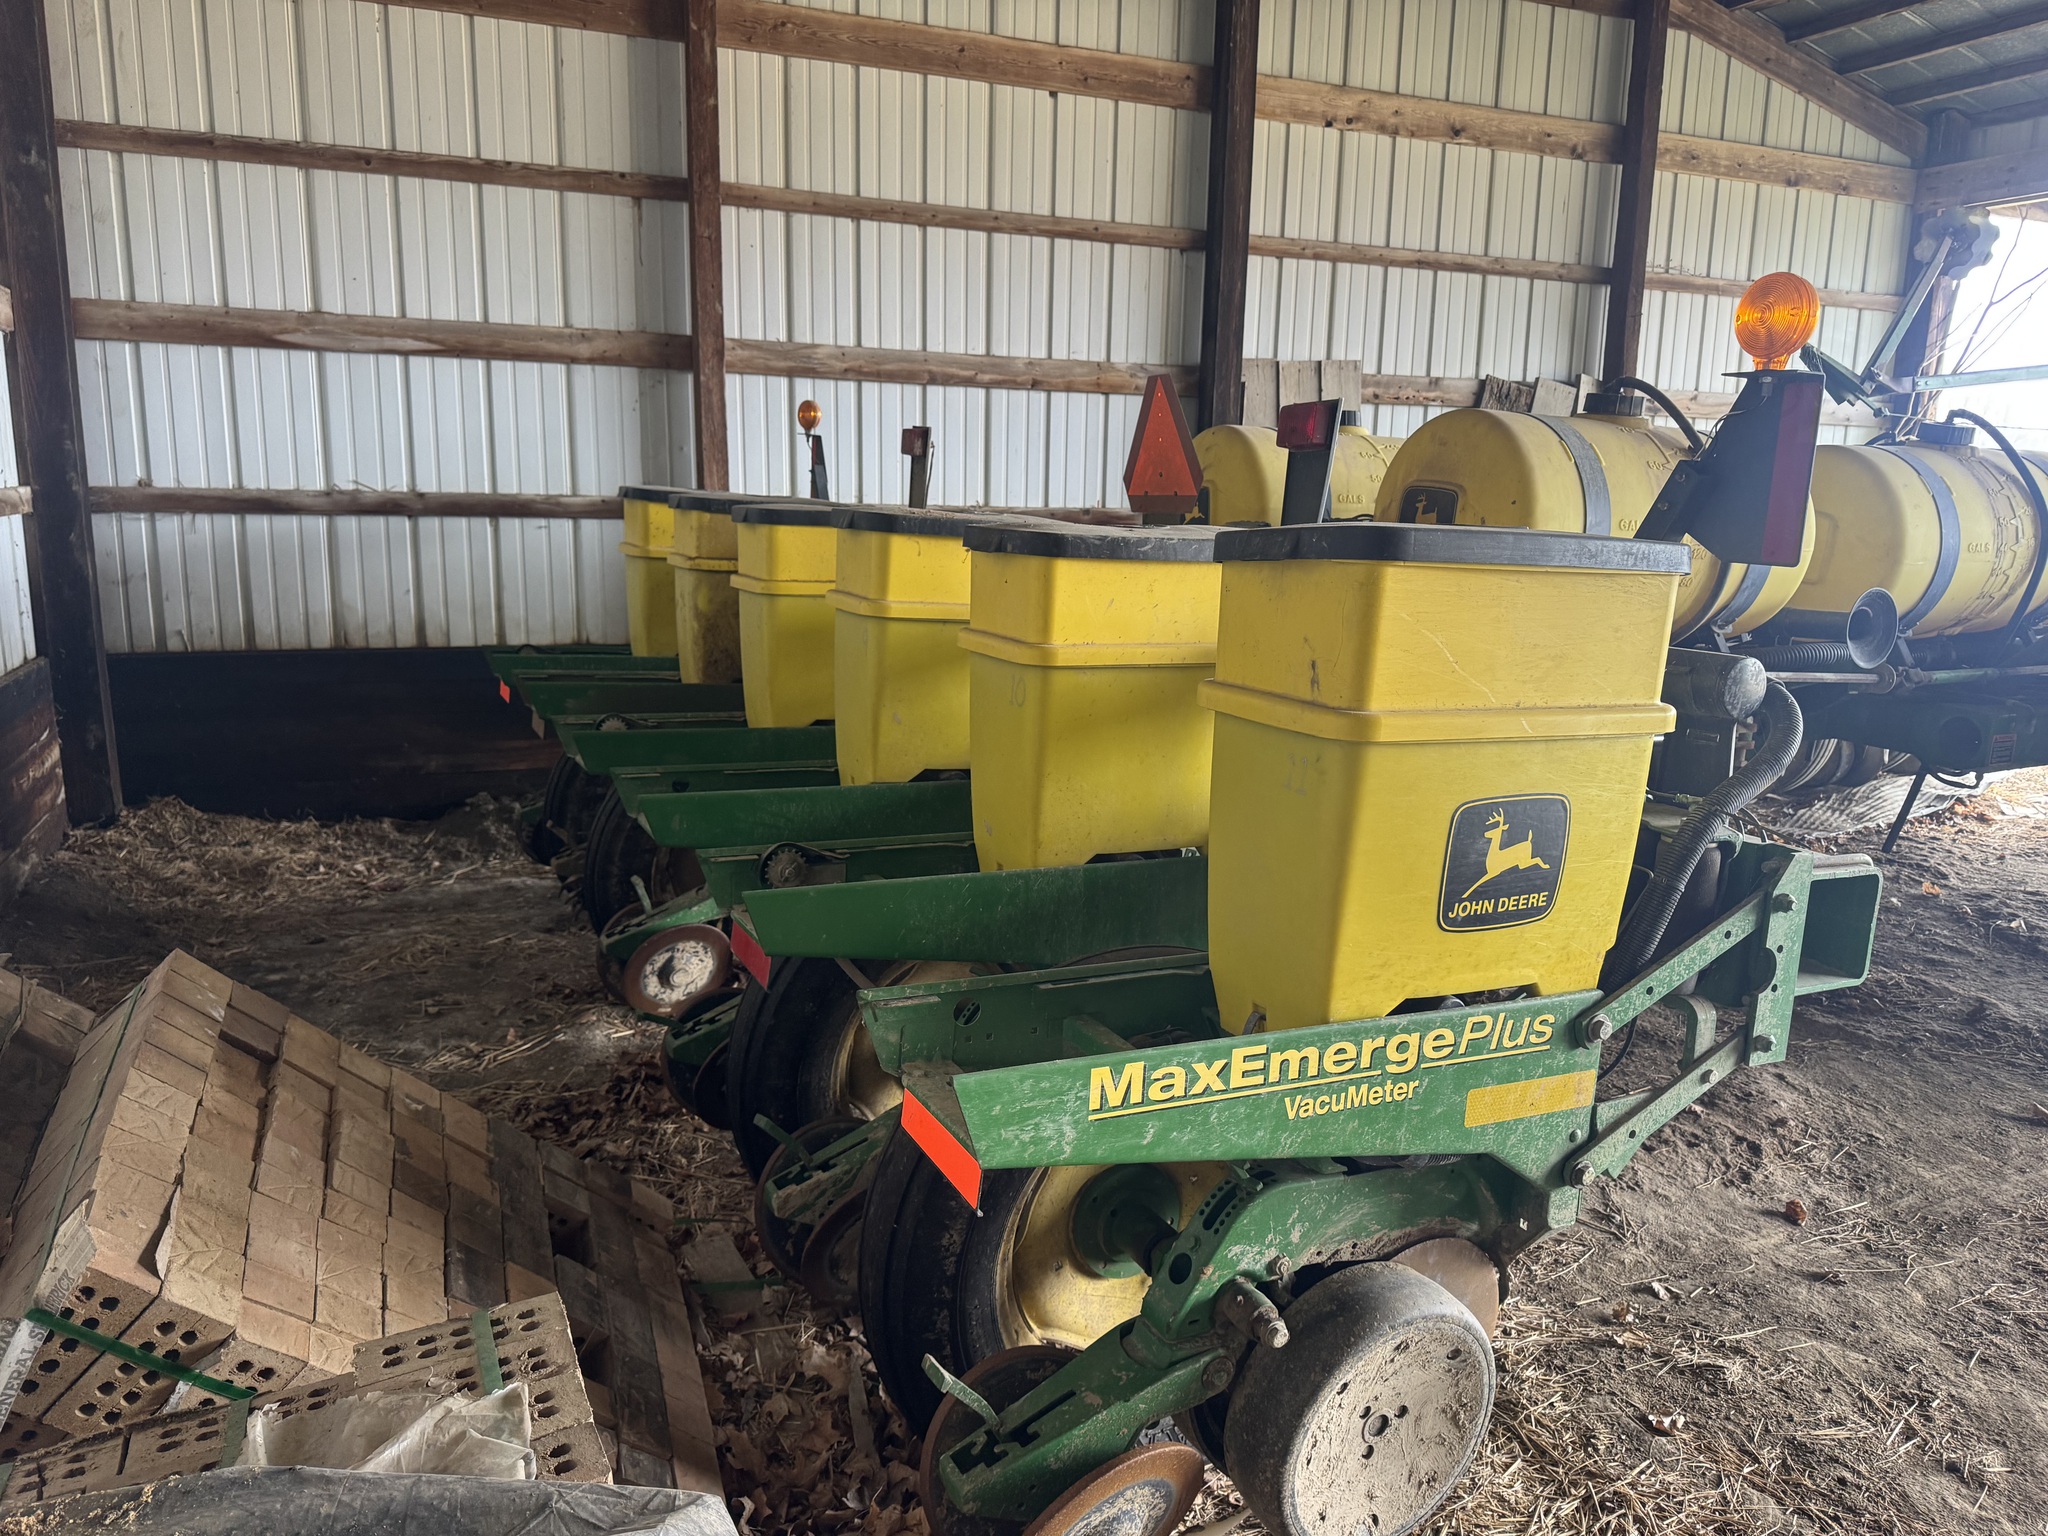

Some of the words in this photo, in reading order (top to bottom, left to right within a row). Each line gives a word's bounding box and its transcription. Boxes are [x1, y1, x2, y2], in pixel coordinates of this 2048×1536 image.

[1646, 460, 1664, 470] 60
[1337, 493, 1366, 505] GALS
[1997, 516, 2010, 527] 50
[1967, 541, 1991, 555] GALS
[1448, 898, 1495, 918] JOHN
[1497, 891, 1549, 912] DEERE
[1283, 1076, 1420, 1121] VacuMeter
[0, 1347, 40, 1424] ENERAL
